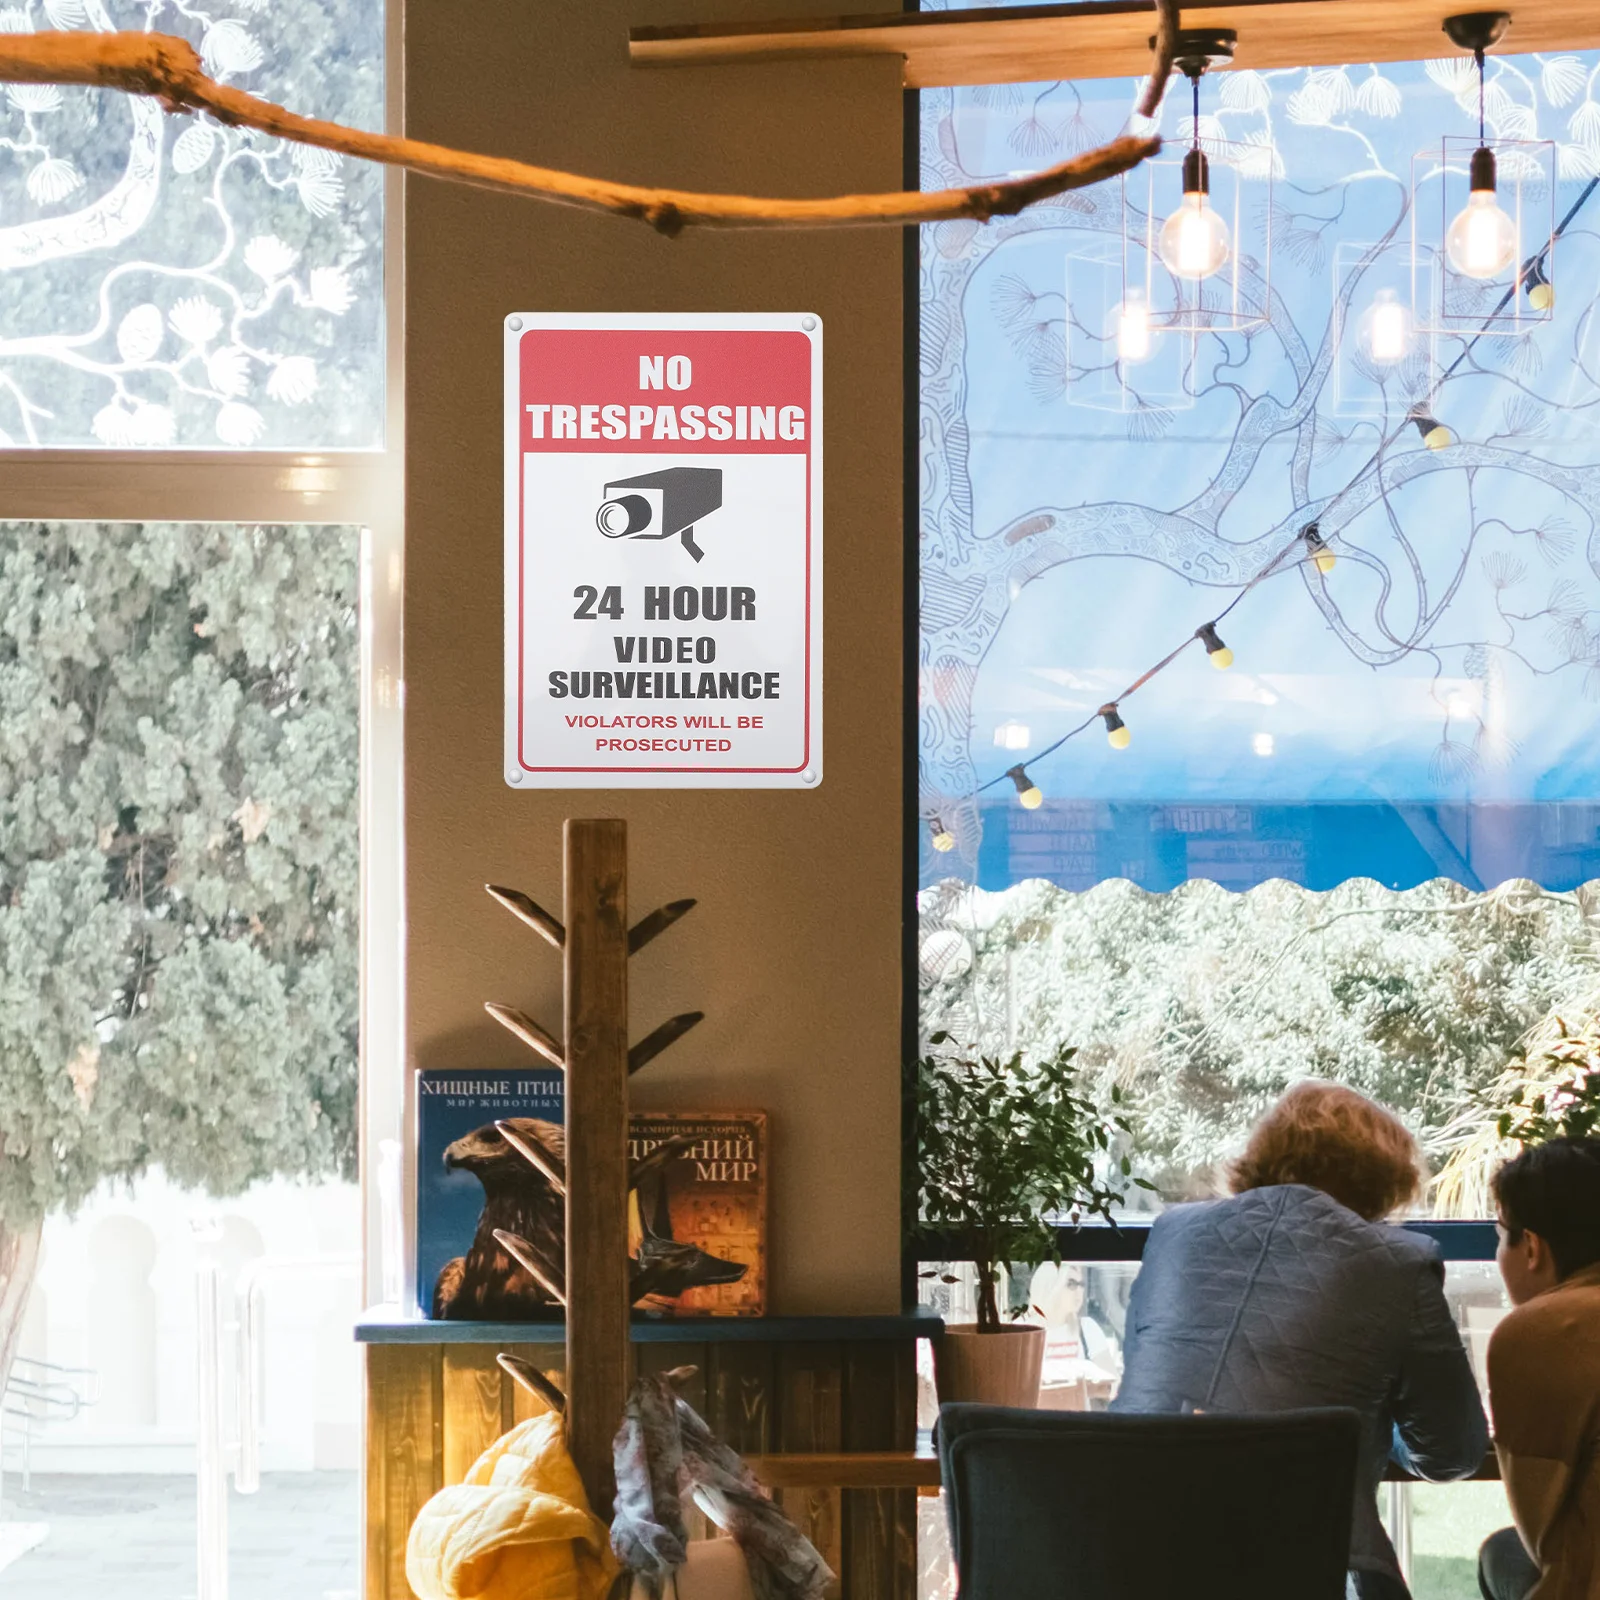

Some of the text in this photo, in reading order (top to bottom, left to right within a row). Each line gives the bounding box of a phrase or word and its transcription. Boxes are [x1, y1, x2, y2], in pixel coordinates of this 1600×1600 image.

[639, 354, 692, 391] NO
[525, 404, 806, 441] TRESPASSING
[573, 584, 756, 622] 24 HOUR
[613, 636, 716, 664] VIDEO
[548, 670, 780, 700] SURVEILLANCE
[564, 714, 764, 729] VIOLATORS WILL BE
[595, 738, 732, 752] PROSECUTED
[421, 1080, 510, 1096] ХИЩНЫЕ
[480, 1099, 560, 1108] ЖИВОТНЫХ
[627, 1134, 754, 1161] ДРНИЙ
[695, 1161, 758, 1182] МИР
